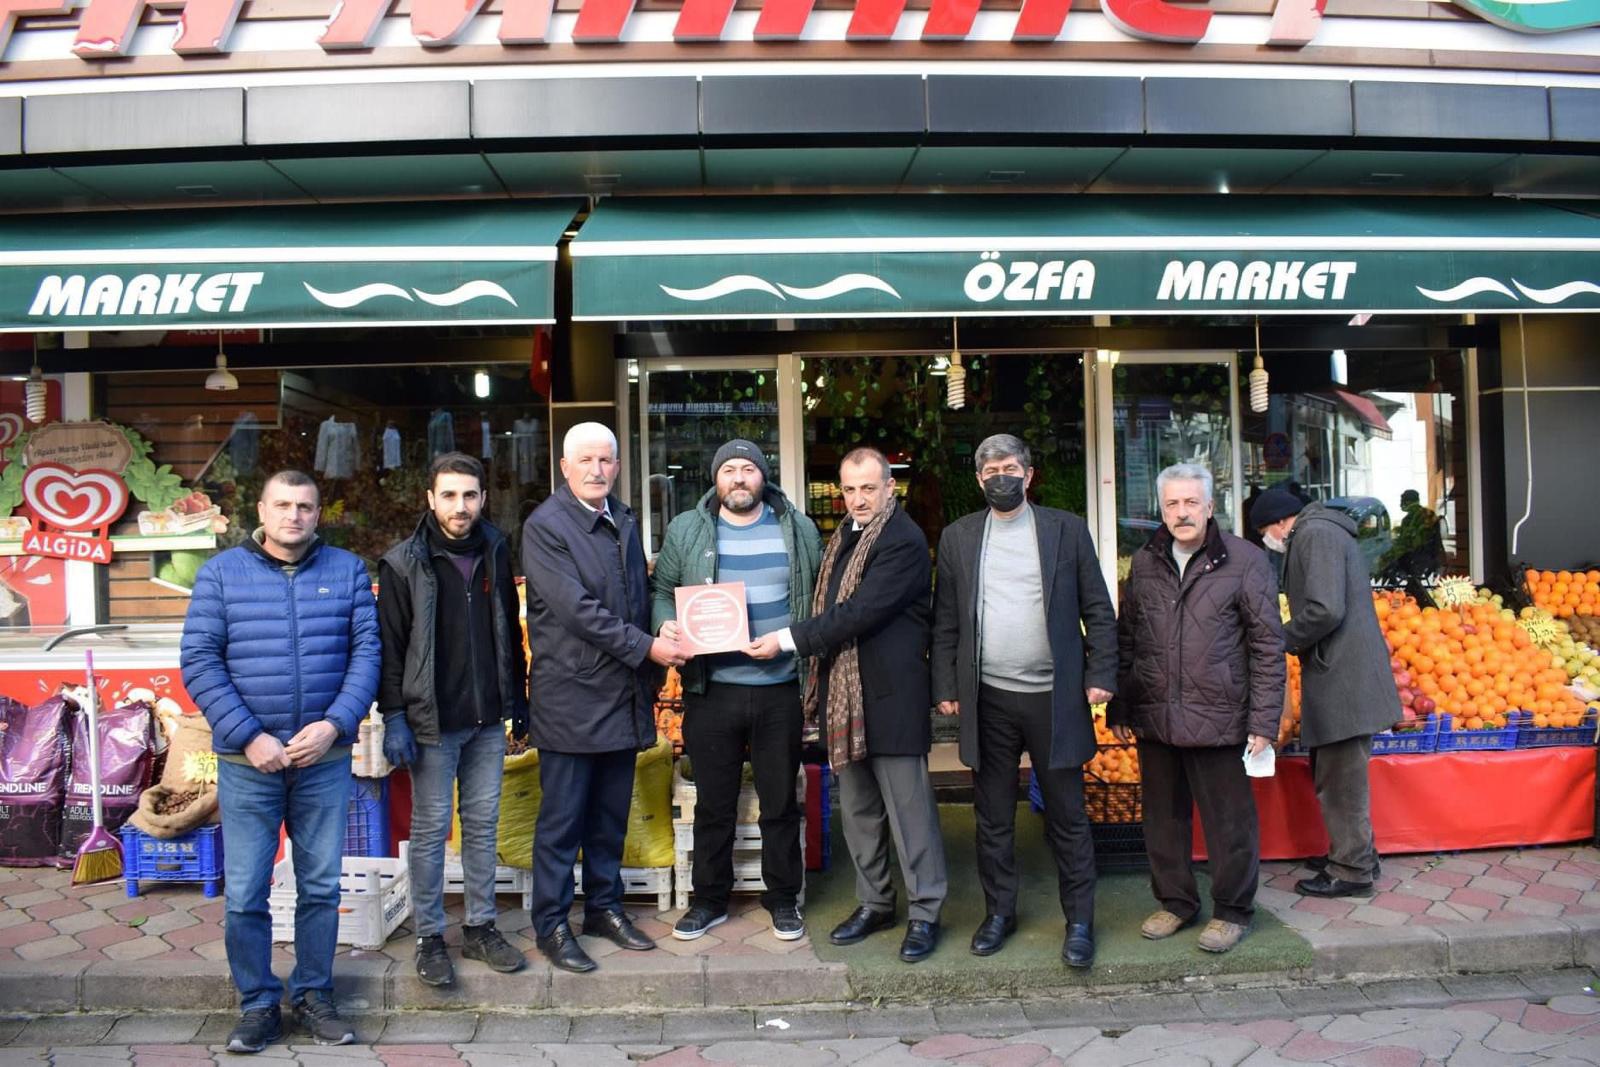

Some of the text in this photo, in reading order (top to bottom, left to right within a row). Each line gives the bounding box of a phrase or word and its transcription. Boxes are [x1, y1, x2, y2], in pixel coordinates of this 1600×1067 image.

[963, 251, 1358, 302] ÖZFA MARKET
[28, 271, 265, 316] MARKET
[1372, 739, 1419, 750] REIS
[1455, 736, 1500, 746] REIS
